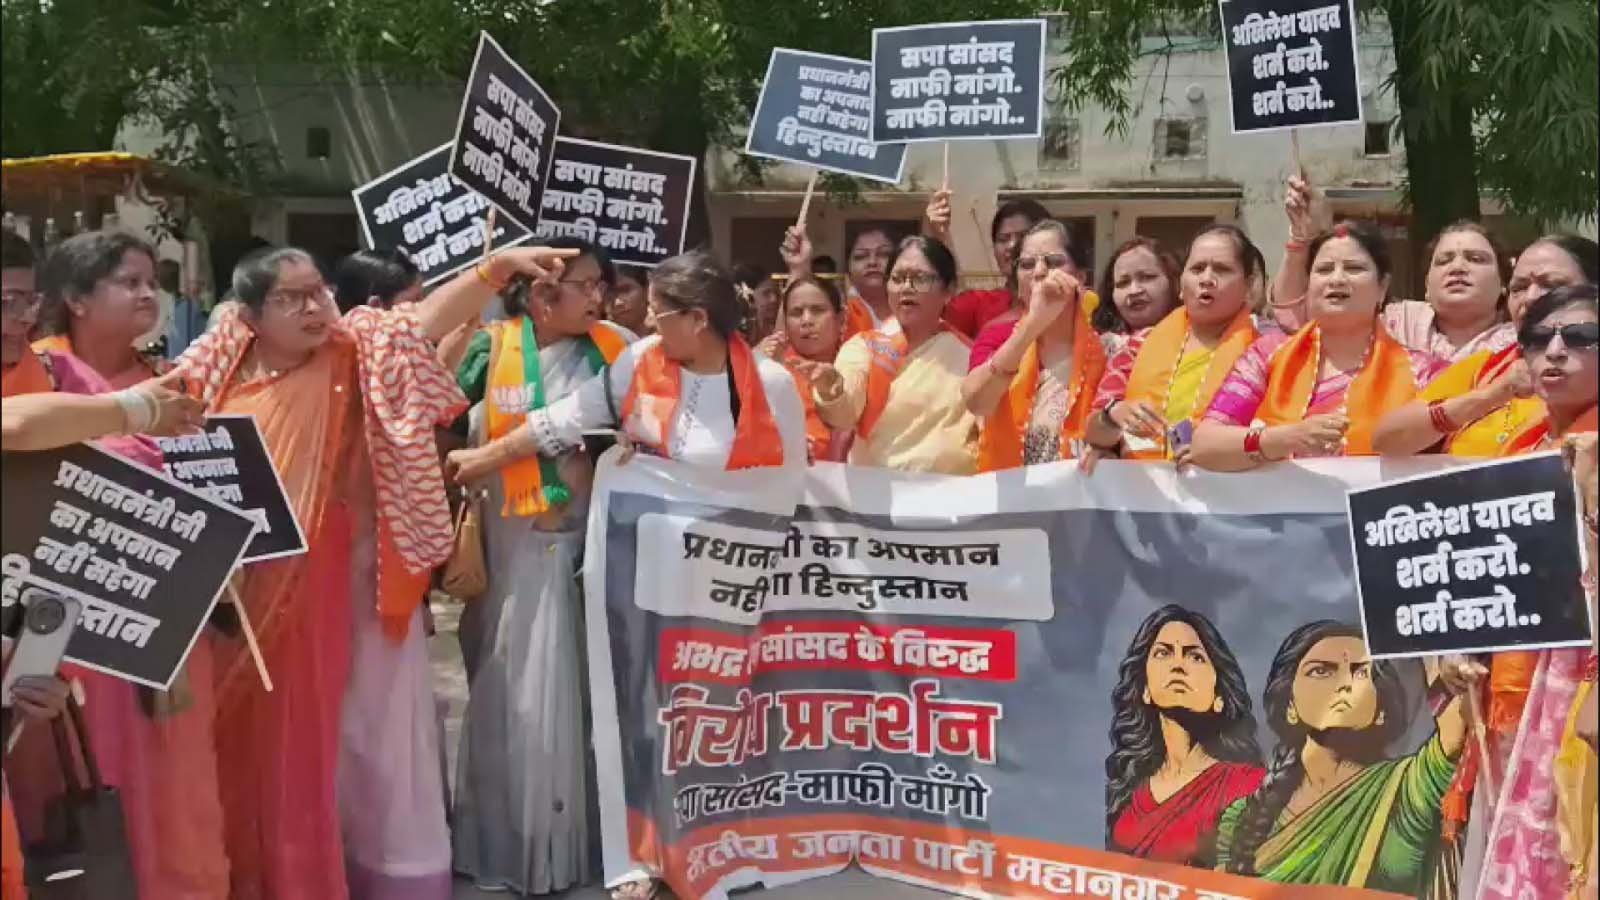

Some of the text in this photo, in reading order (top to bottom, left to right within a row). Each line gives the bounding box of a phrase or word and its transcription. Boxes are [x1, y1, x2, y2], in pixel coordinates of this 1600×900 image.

[1232, 4, 1341, 46] अखिलेश यादव
[901, 36, 1016, 69] सपा सांसद
[1253, 42, 1286, 79] शर्म
[800, 84, 823, 102] का
[890, 69, 952, 99] माफी
[1253, 80, 1286, 116] शर्म
[473, 105, 514, 154] माफी
[487, 73, 546, 146] सपा सांसद
[797, 103, 869, 131] नहीं सहेगा
[886, 99, 946, 130] माफी
[776, 116, 878, 160] हिन्दुस्तान
[463, 141, 504, 188] माफी
[555, 160, 667, 197] सपा सांसद
[373, 172, 453, 225] अखिलेश
[542, 188, 605, 217] माफी
[402, 201, 444, 244] शर्म
[53, 460, 176, 530] प्रधानमंत्री
[169, 508, 208, 543] जी
[1364, 491, 1556, 547] अखिलेश यादव
[50, 500, 182, 571] का अपमान
[808, 534, 859, 560] का
[867, 537, 1000, 567] अपमान
[34, 536, 158, 600] नहीं सहेगा
[1396, 534, 1532, 589] शर्म करो.
[799, 562, 970, 610] हिन्दुस्तान
[1395, 589, 1453, 637] शर्म
[760, 624, 850, 663] सांसद
[854, 625, 886, 662] के
[890, 629, 994, 674] विरुद्ध
[775, 679, 1003, 766] प्रदर्शन
[901, 765, 992, 822] माँगो
[787, 830, 905, 861] जनता
[912, 837, 996, 879] पार्टी
[1006, 853, 1187, 900] महानगर
